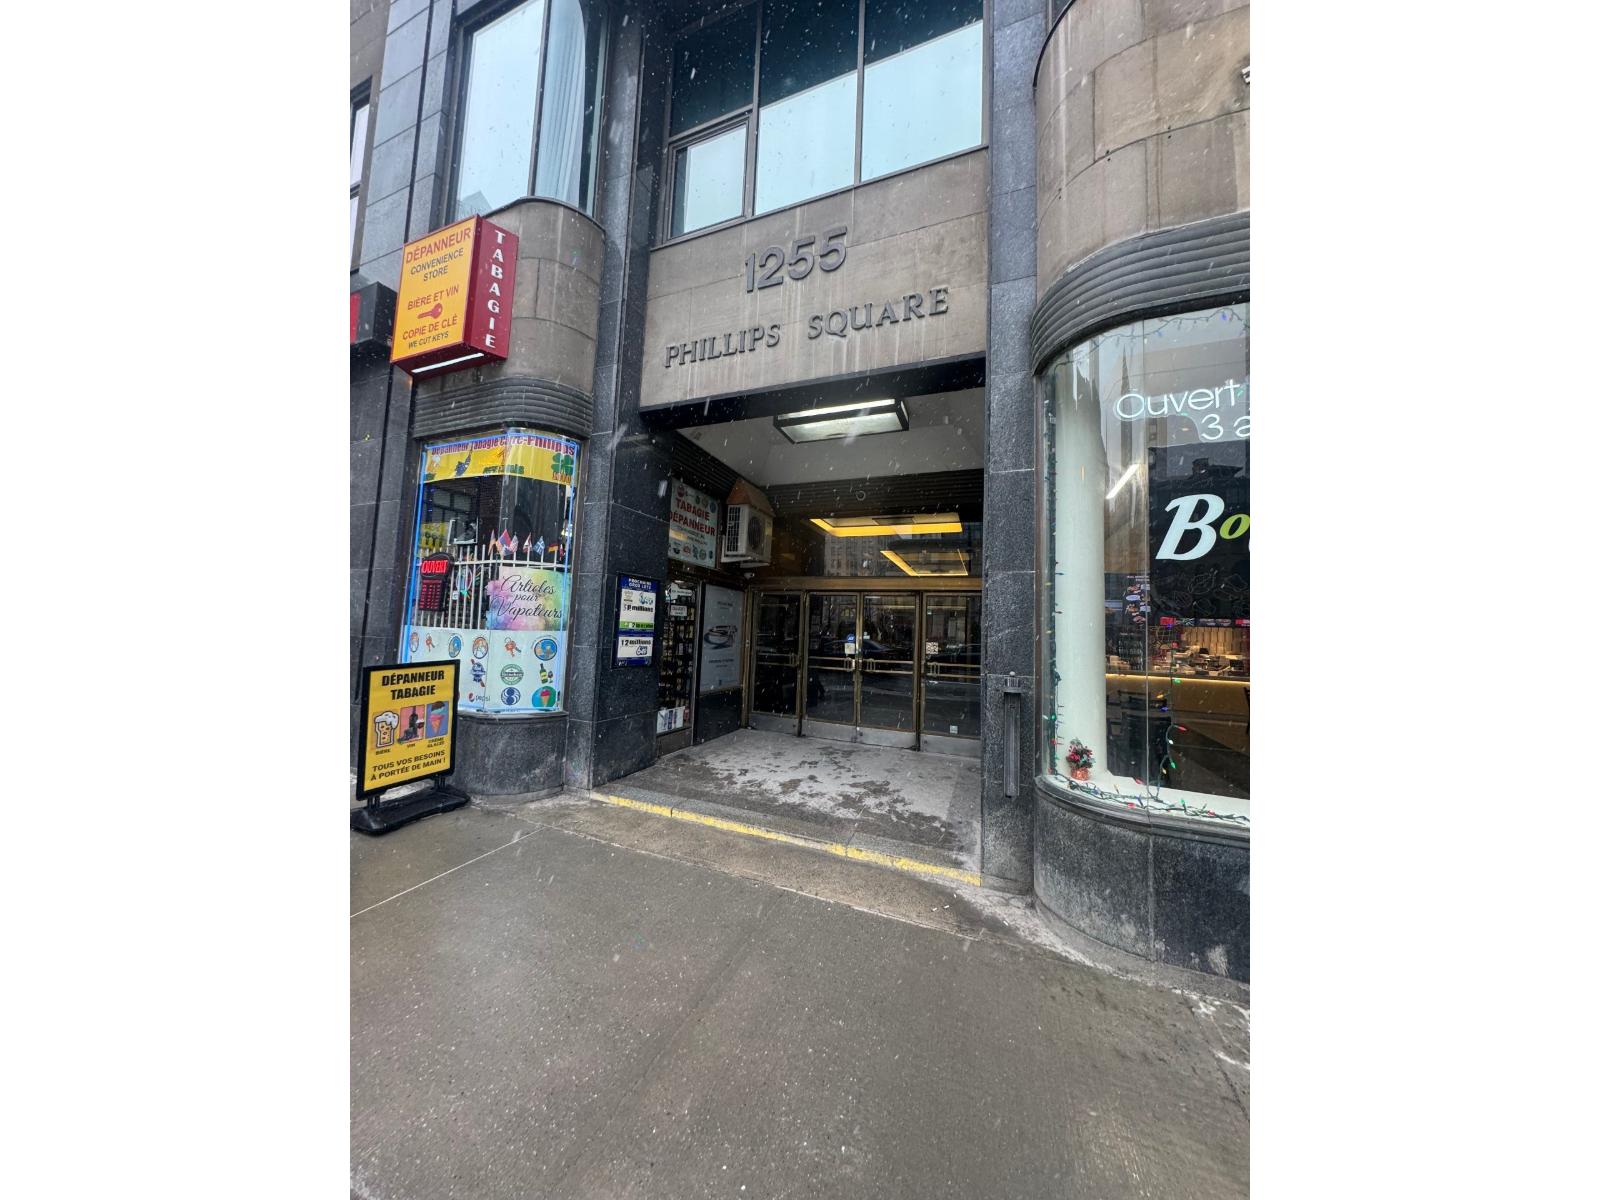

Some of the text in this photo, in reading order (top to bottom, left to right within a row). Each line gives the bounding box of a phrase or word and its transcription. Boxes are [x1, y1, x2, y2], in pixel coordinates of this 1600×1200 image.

[405, 227, 471, 264] DÉPANNEUR
[410, 247, 464, 275] CONVENIENCE
[745, 226, 847, 294] 1255
[423, 265, 449, 282] STORE
[407, 284, 459, 310] BIÈRE ET VIN
[485, 229, 506, 349] TABAGIE
[402, 314, 458, 340] COPIE DE CLÉ
[408, 331, 449, 349] WE CUT KEYS
[664, 286, 950, 368] PHILLIPS SQUARE
[1114, 379, 1240, 421] Ouvert
[1201, 413, 1224, 440] 3
[675, 498, 710, 521] TABAGIE
[1155, 493, 1250, 561] Bo
[421, 559, 449, 574] OUVERT
[500, 574, 556, 596] Articles
[381, 669, 445, 687] DÉPANNEUR
[390, 685, 436, 700] TABAGIE
[372, 749, 446, 772] TOUS VOS BESOINS
[378, 765, 411, 779] PORTÉE
[411, 763, 421, 771] DE
[422, 758, 442, 769] MAIN
